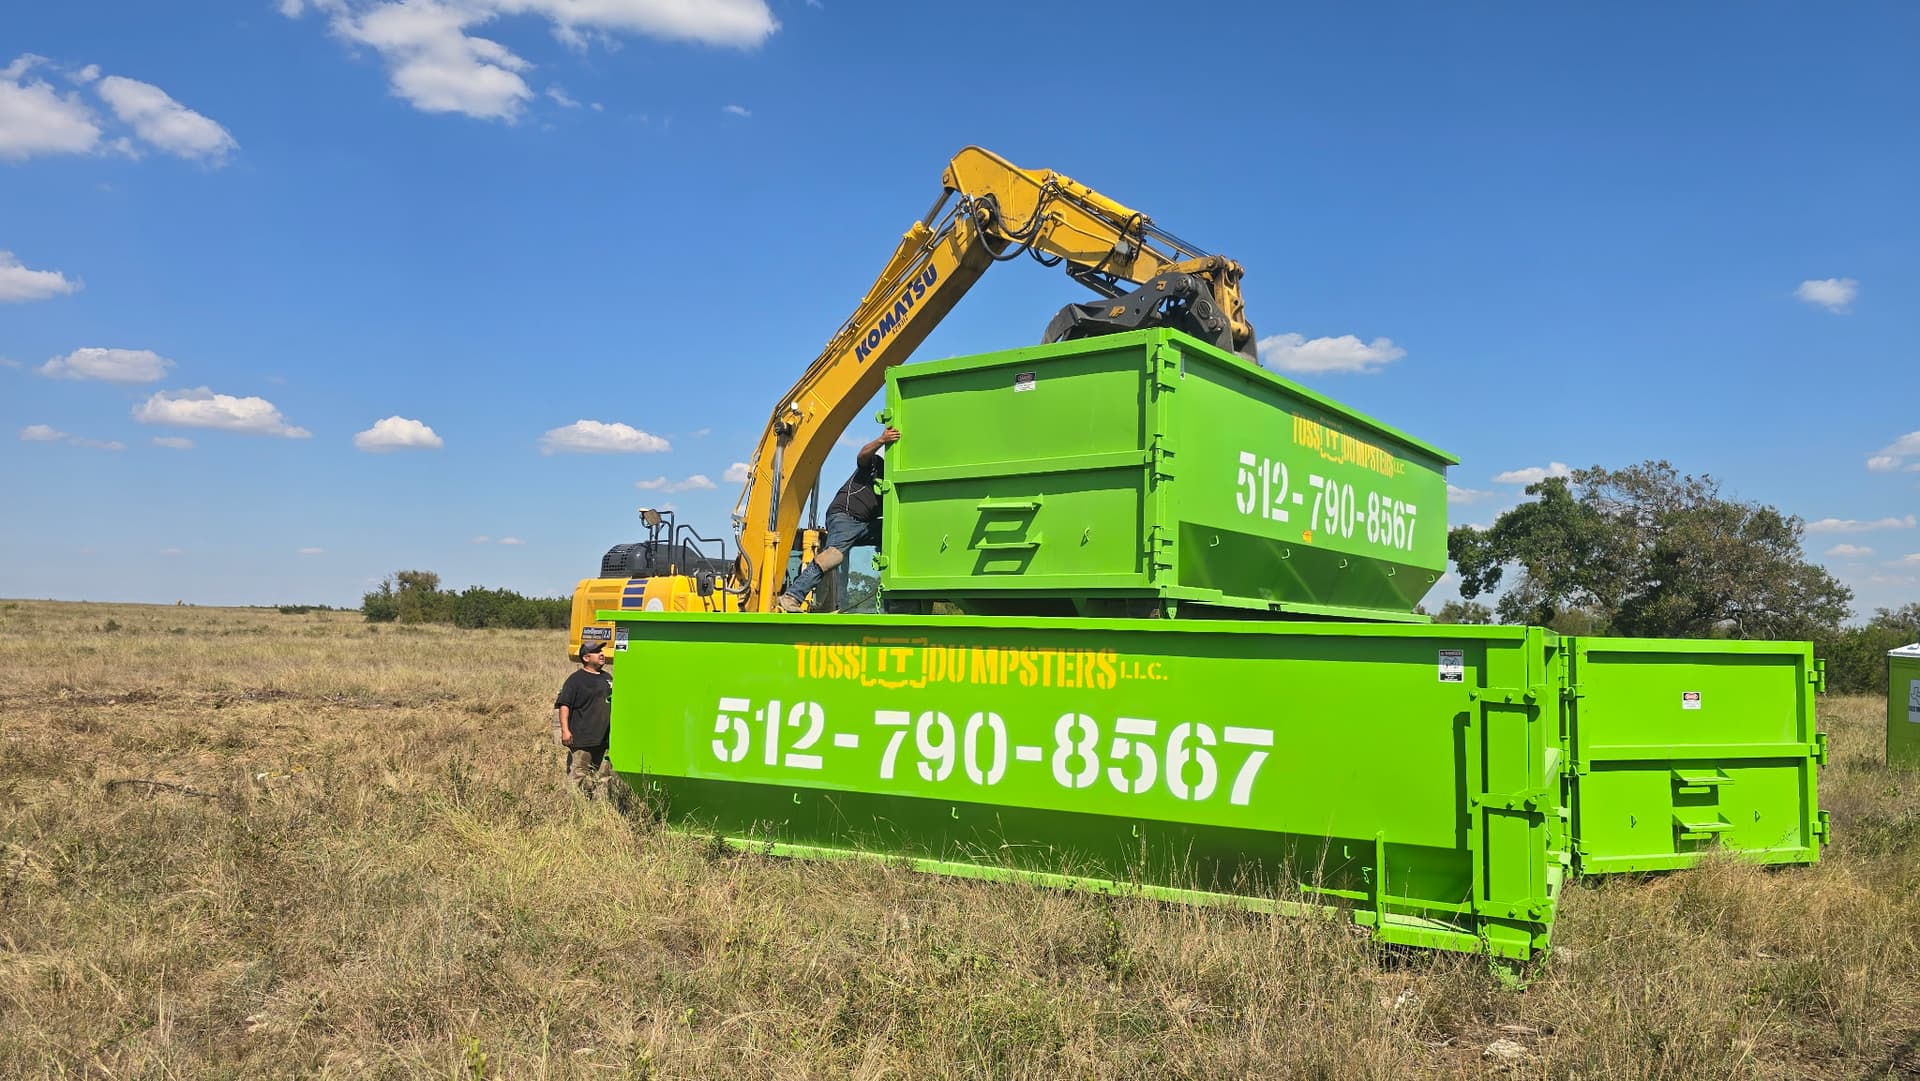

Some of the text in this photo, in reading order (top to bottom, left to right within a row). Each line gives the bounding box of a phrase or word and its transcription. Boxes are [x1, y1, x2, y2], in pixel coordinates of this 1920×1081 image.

[855, 263, 938, 363] KOMATSU
[1293, 412, 1320, 451] TOSS
[1236, 451, 1417, 551] 512-790-8567
[795, 642, 860, 679] TOSS
[878, 649, 914, 673] IT
[711, 697, 1274, 806] 512-790-8567
